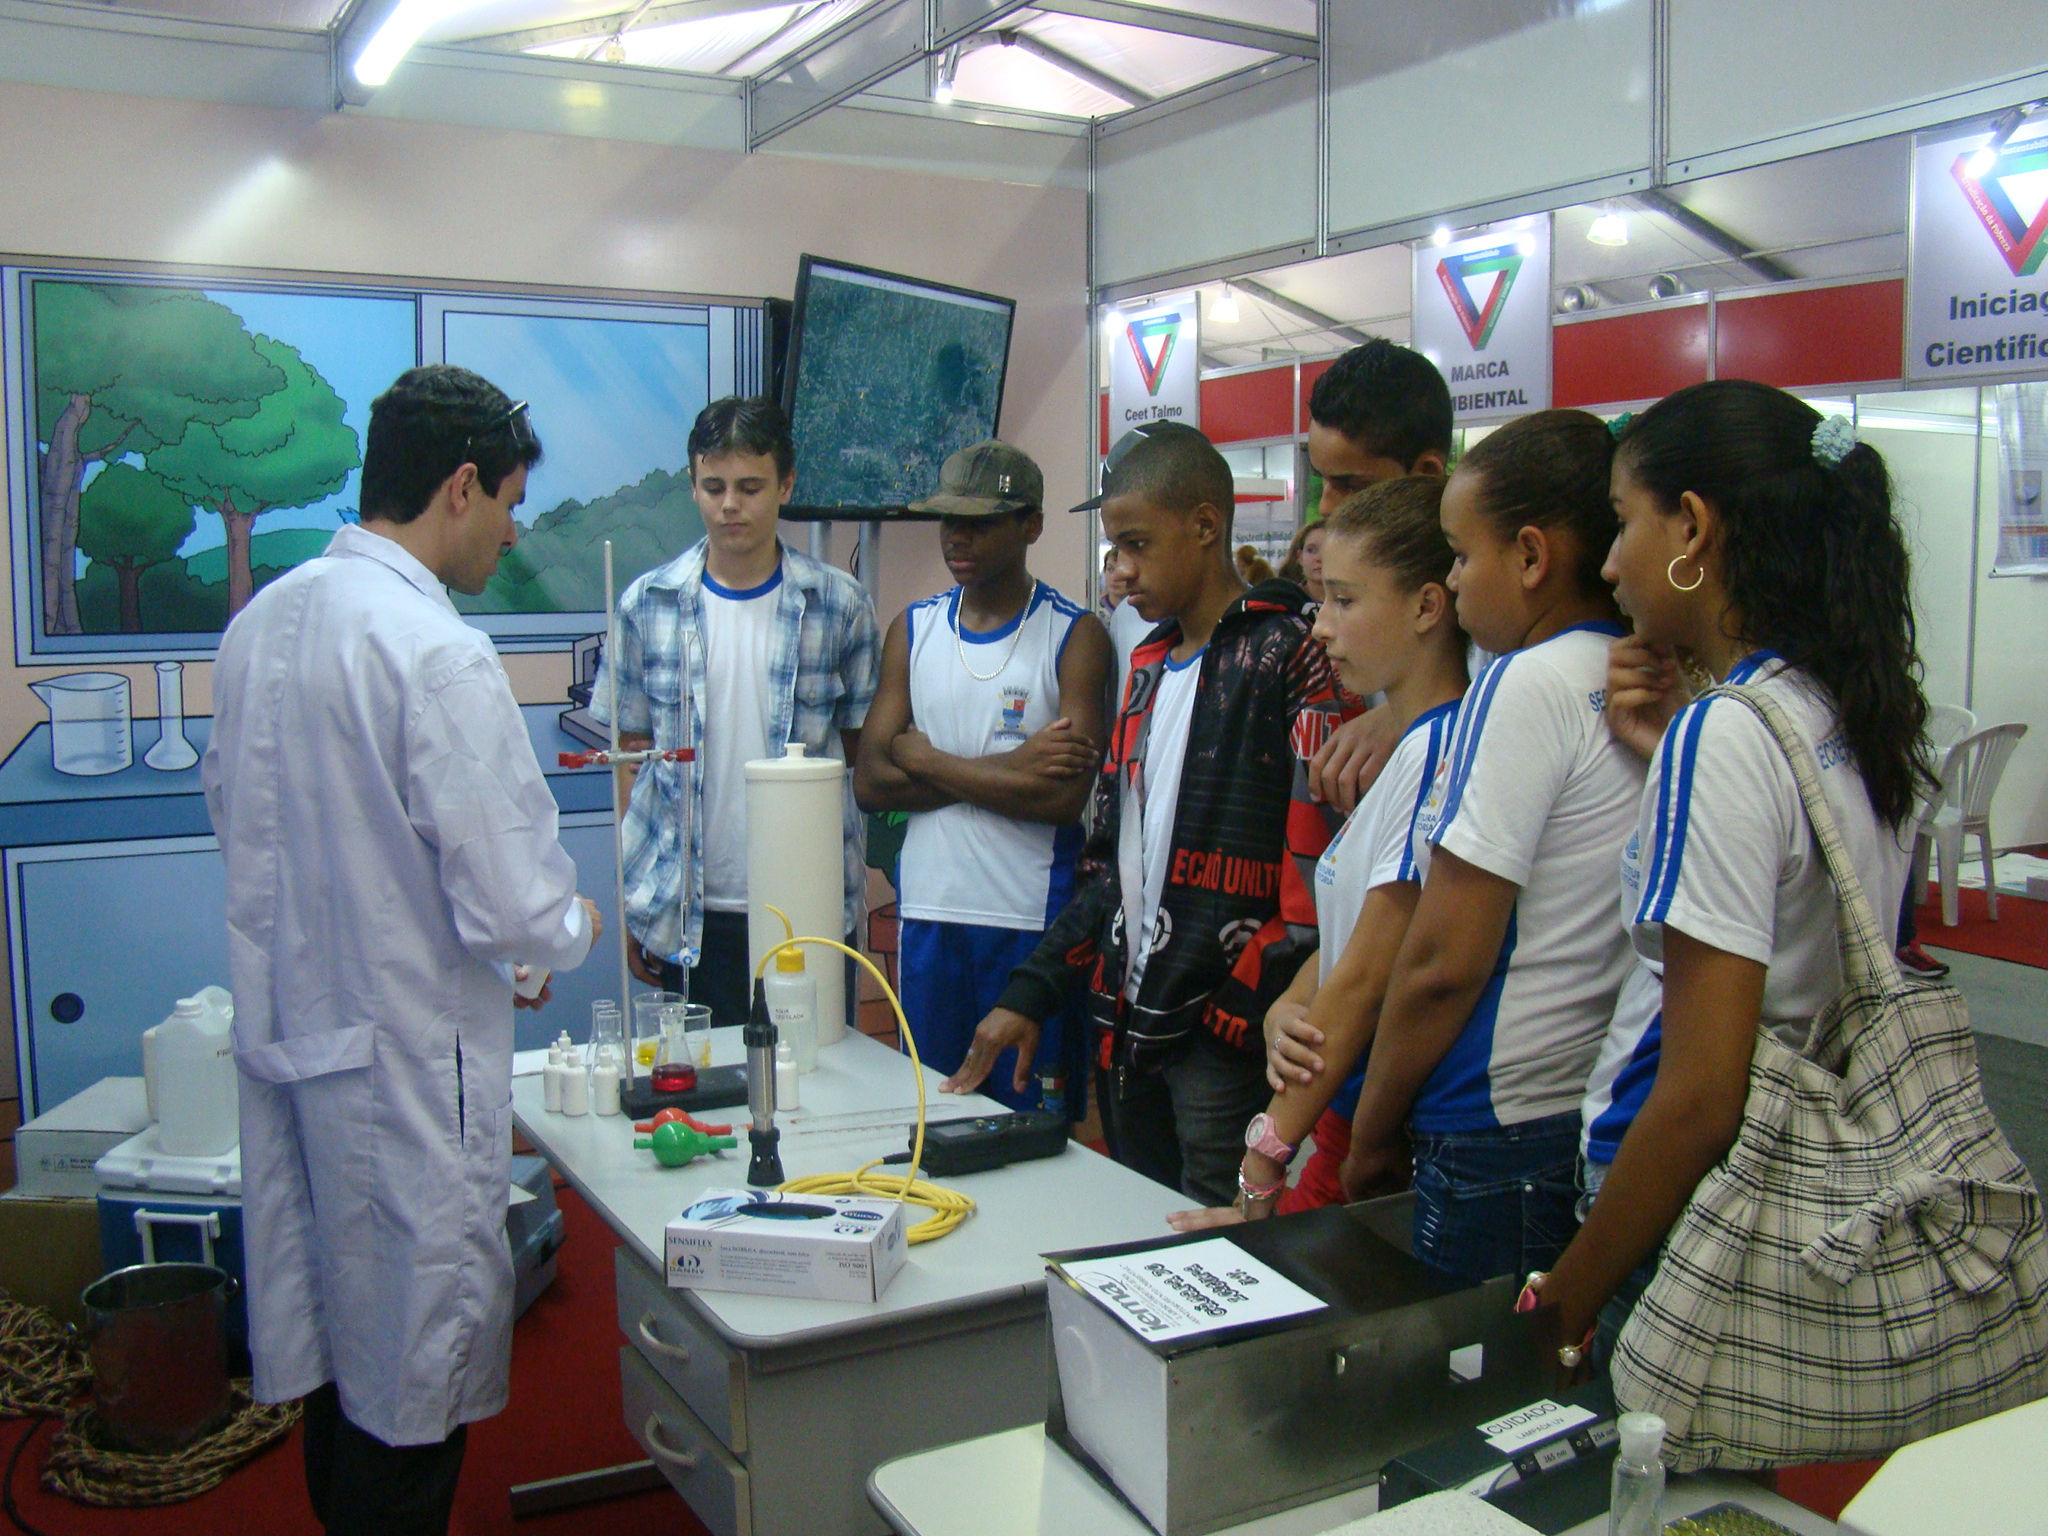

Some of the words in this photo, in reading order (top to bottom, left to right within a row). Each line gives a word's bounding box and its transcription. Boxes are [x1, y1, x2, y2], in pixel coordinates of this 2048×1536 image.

[1991, 222, 2012, 253] Pobreza
[1451, 360, 1509, 382] MARCA
[1125, 407, 1148, 421] Ceet
[1151, 405, 1182, 419] Talmo
[668, 1236, 713, 1248] SENSIFLEX
[670, 1266, 704, 1275] DANNY
[1099, 1280, 1170, 1333] iema
[1486, 1403, 1558, 1434] CUIDADO
